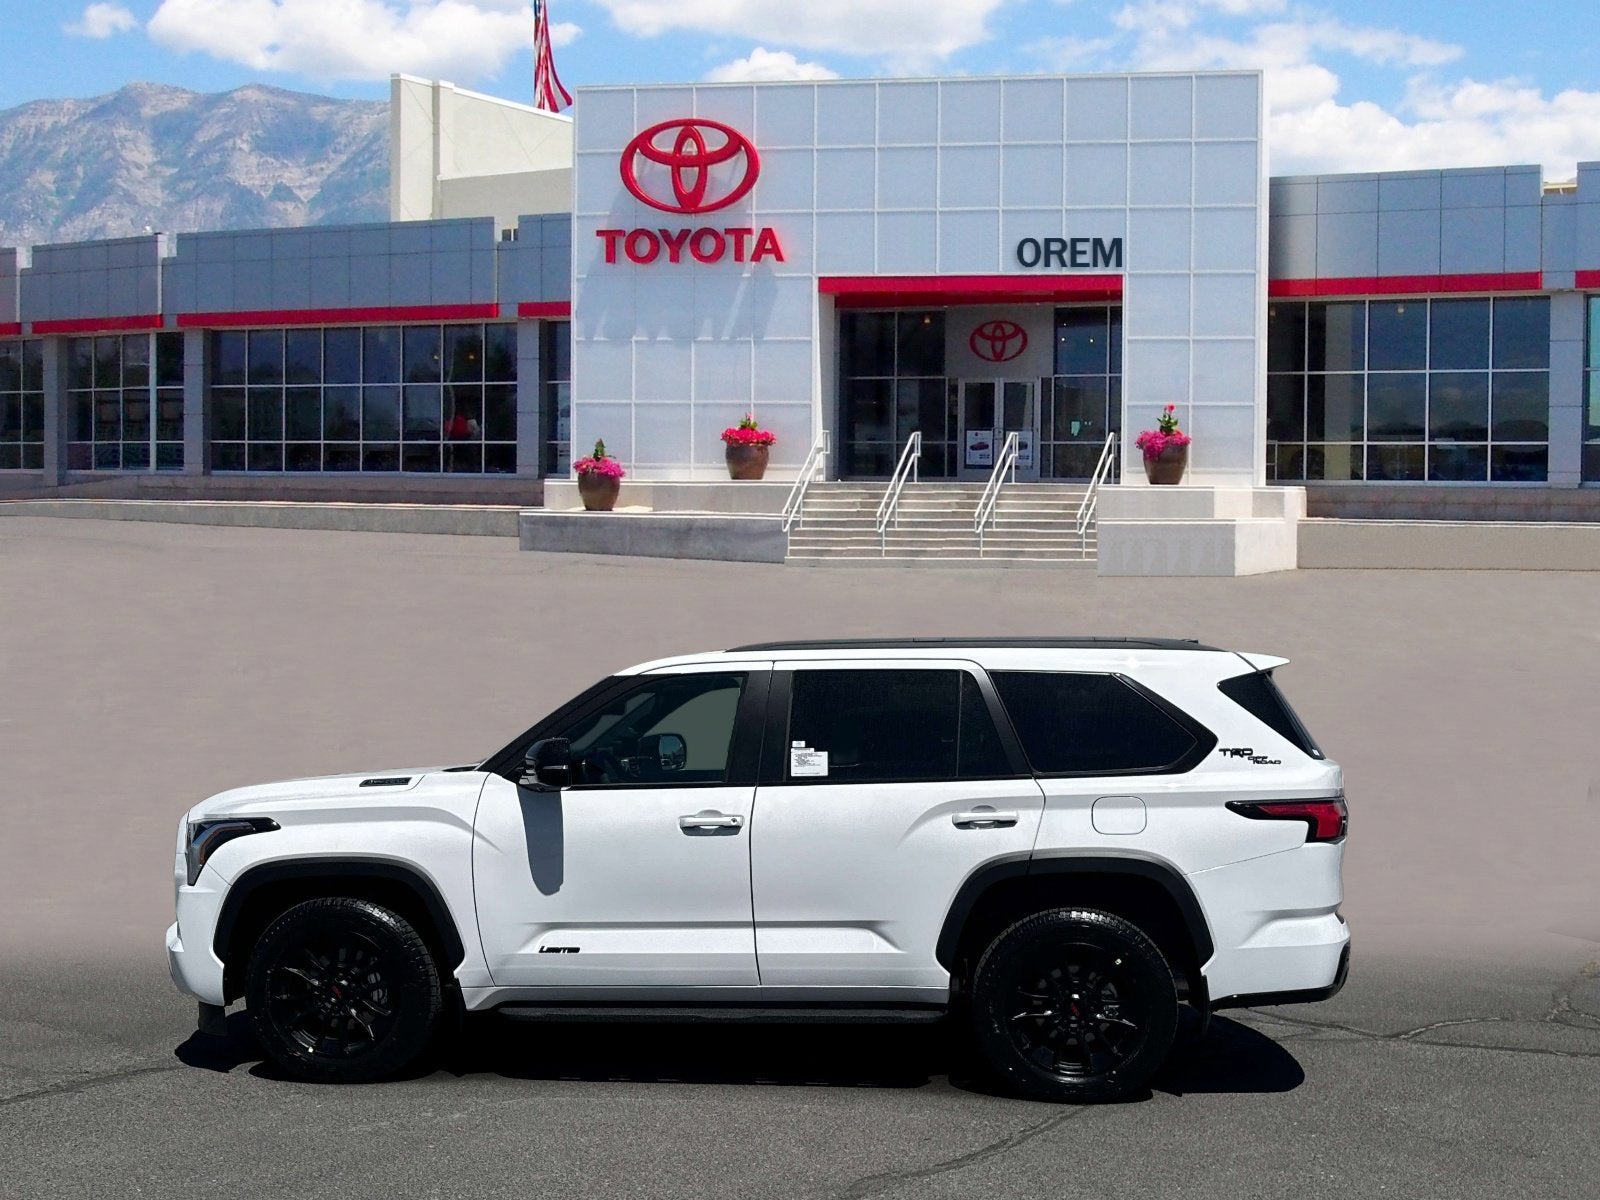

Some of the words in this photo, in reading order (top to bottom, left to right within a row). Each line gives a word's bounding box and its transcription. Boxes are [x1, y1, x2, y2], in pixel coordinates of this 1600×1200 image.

[596, 227, 785, 264] TOYOTA
[1017, 237, 1122, 268] OREM
[1218, 748, 1253, 758] TRD
